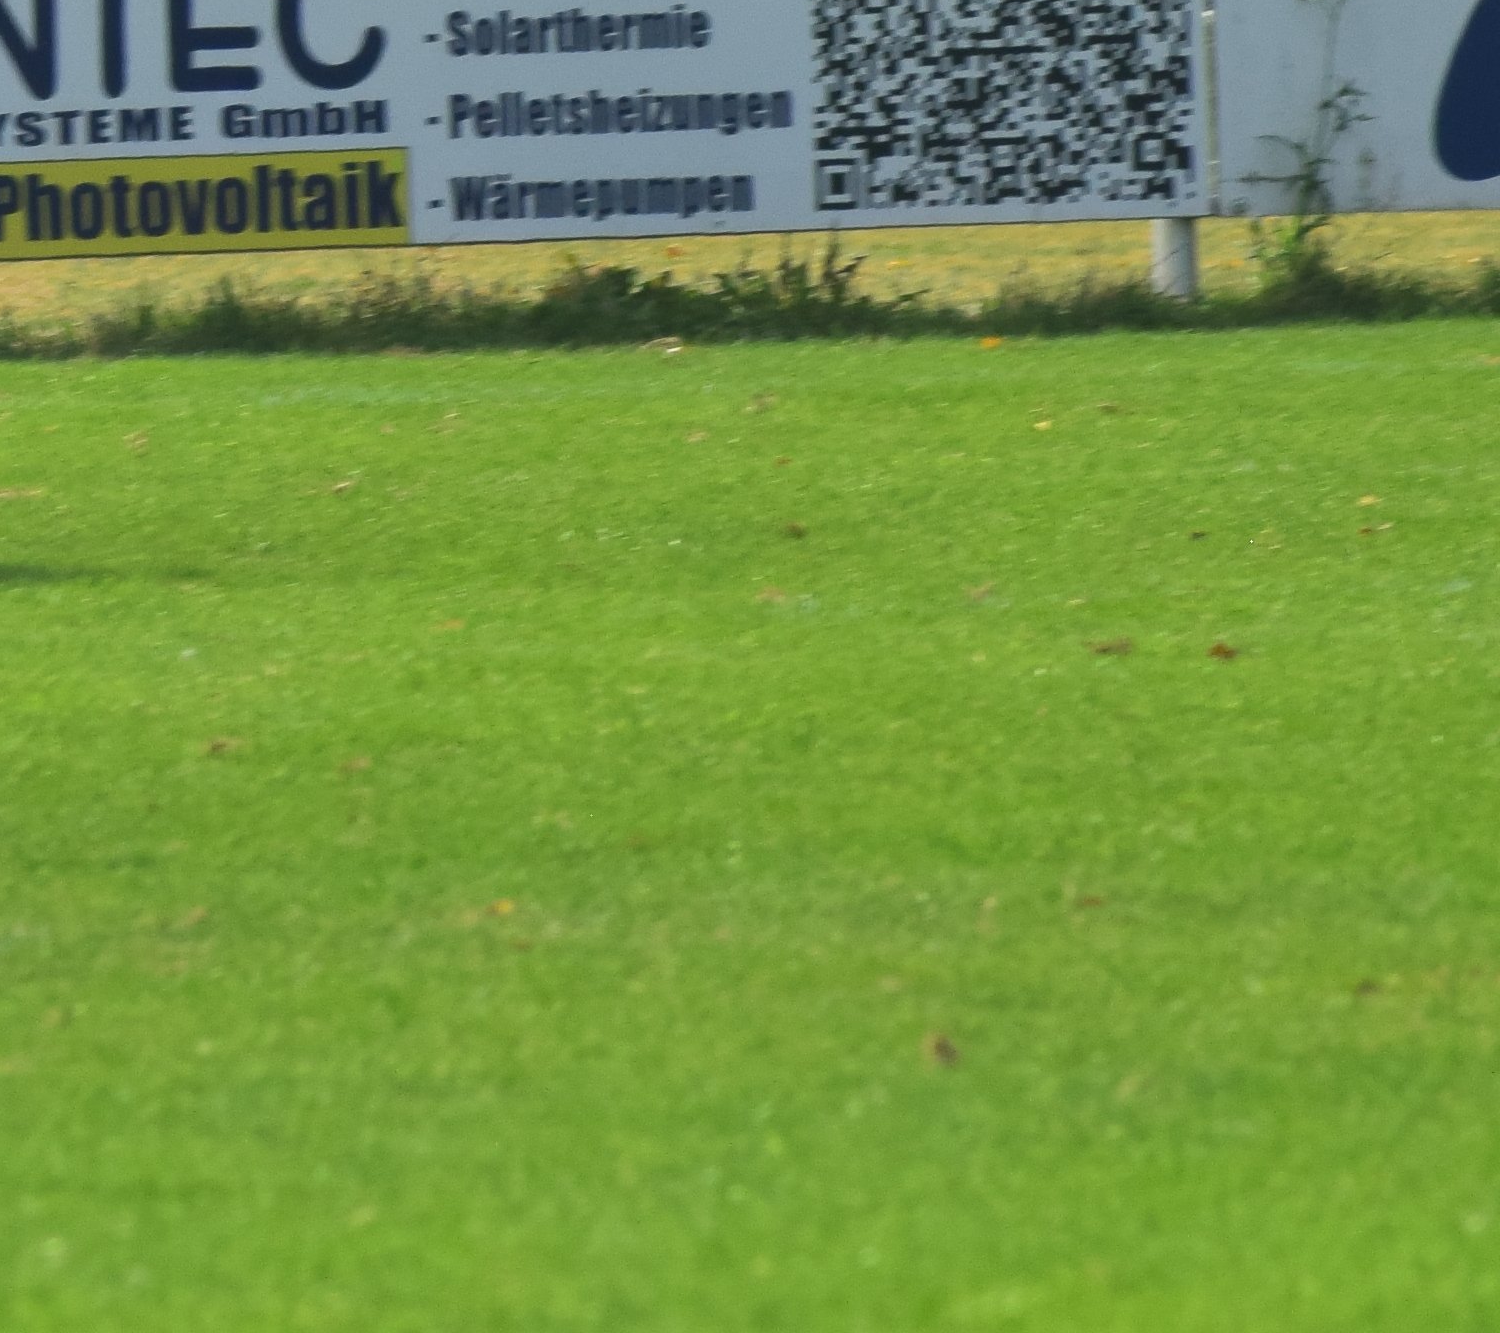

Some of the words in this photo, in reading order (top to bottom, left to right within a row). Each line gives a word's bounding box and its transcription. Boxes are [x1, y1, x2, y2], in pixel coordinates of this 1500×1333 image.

[446, 4, 713, 57] Solarthermie
[220, 100, 388, 140] GmbH
[448, 88, 794, 139] Pelletsheizungen
[450, 174, 755, 221] Wärmepumpen
